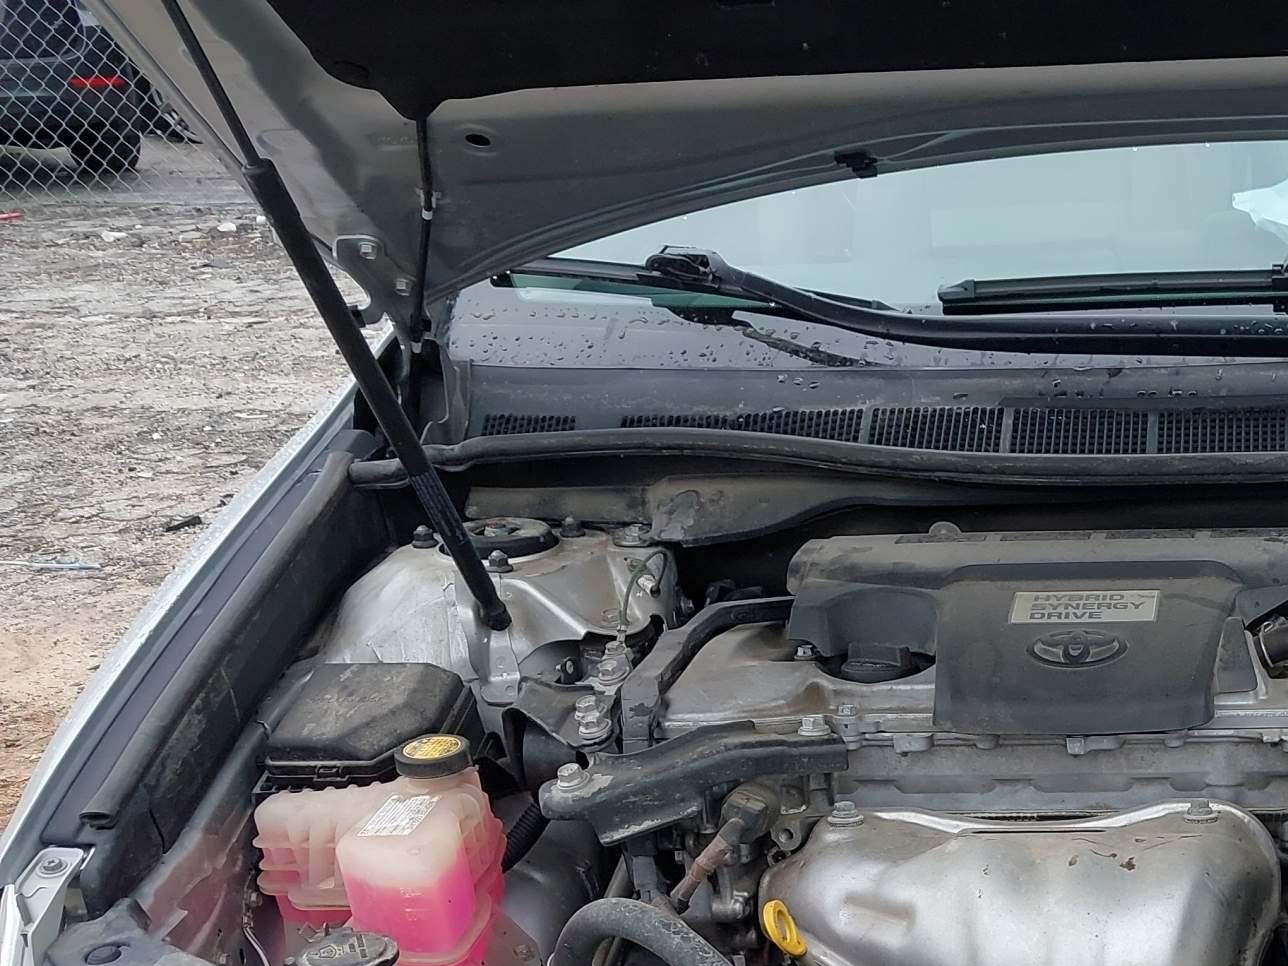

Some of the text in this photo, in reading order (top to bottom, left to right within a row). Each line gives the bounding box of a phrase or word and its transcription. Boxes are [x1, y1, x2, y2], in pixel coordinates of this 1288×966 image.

[1034, 593, 1125, 602] HYBRID
[1031, 601, 1145, 611] SYNERGY
[1029, 611, 1103, 620] DRIVE
